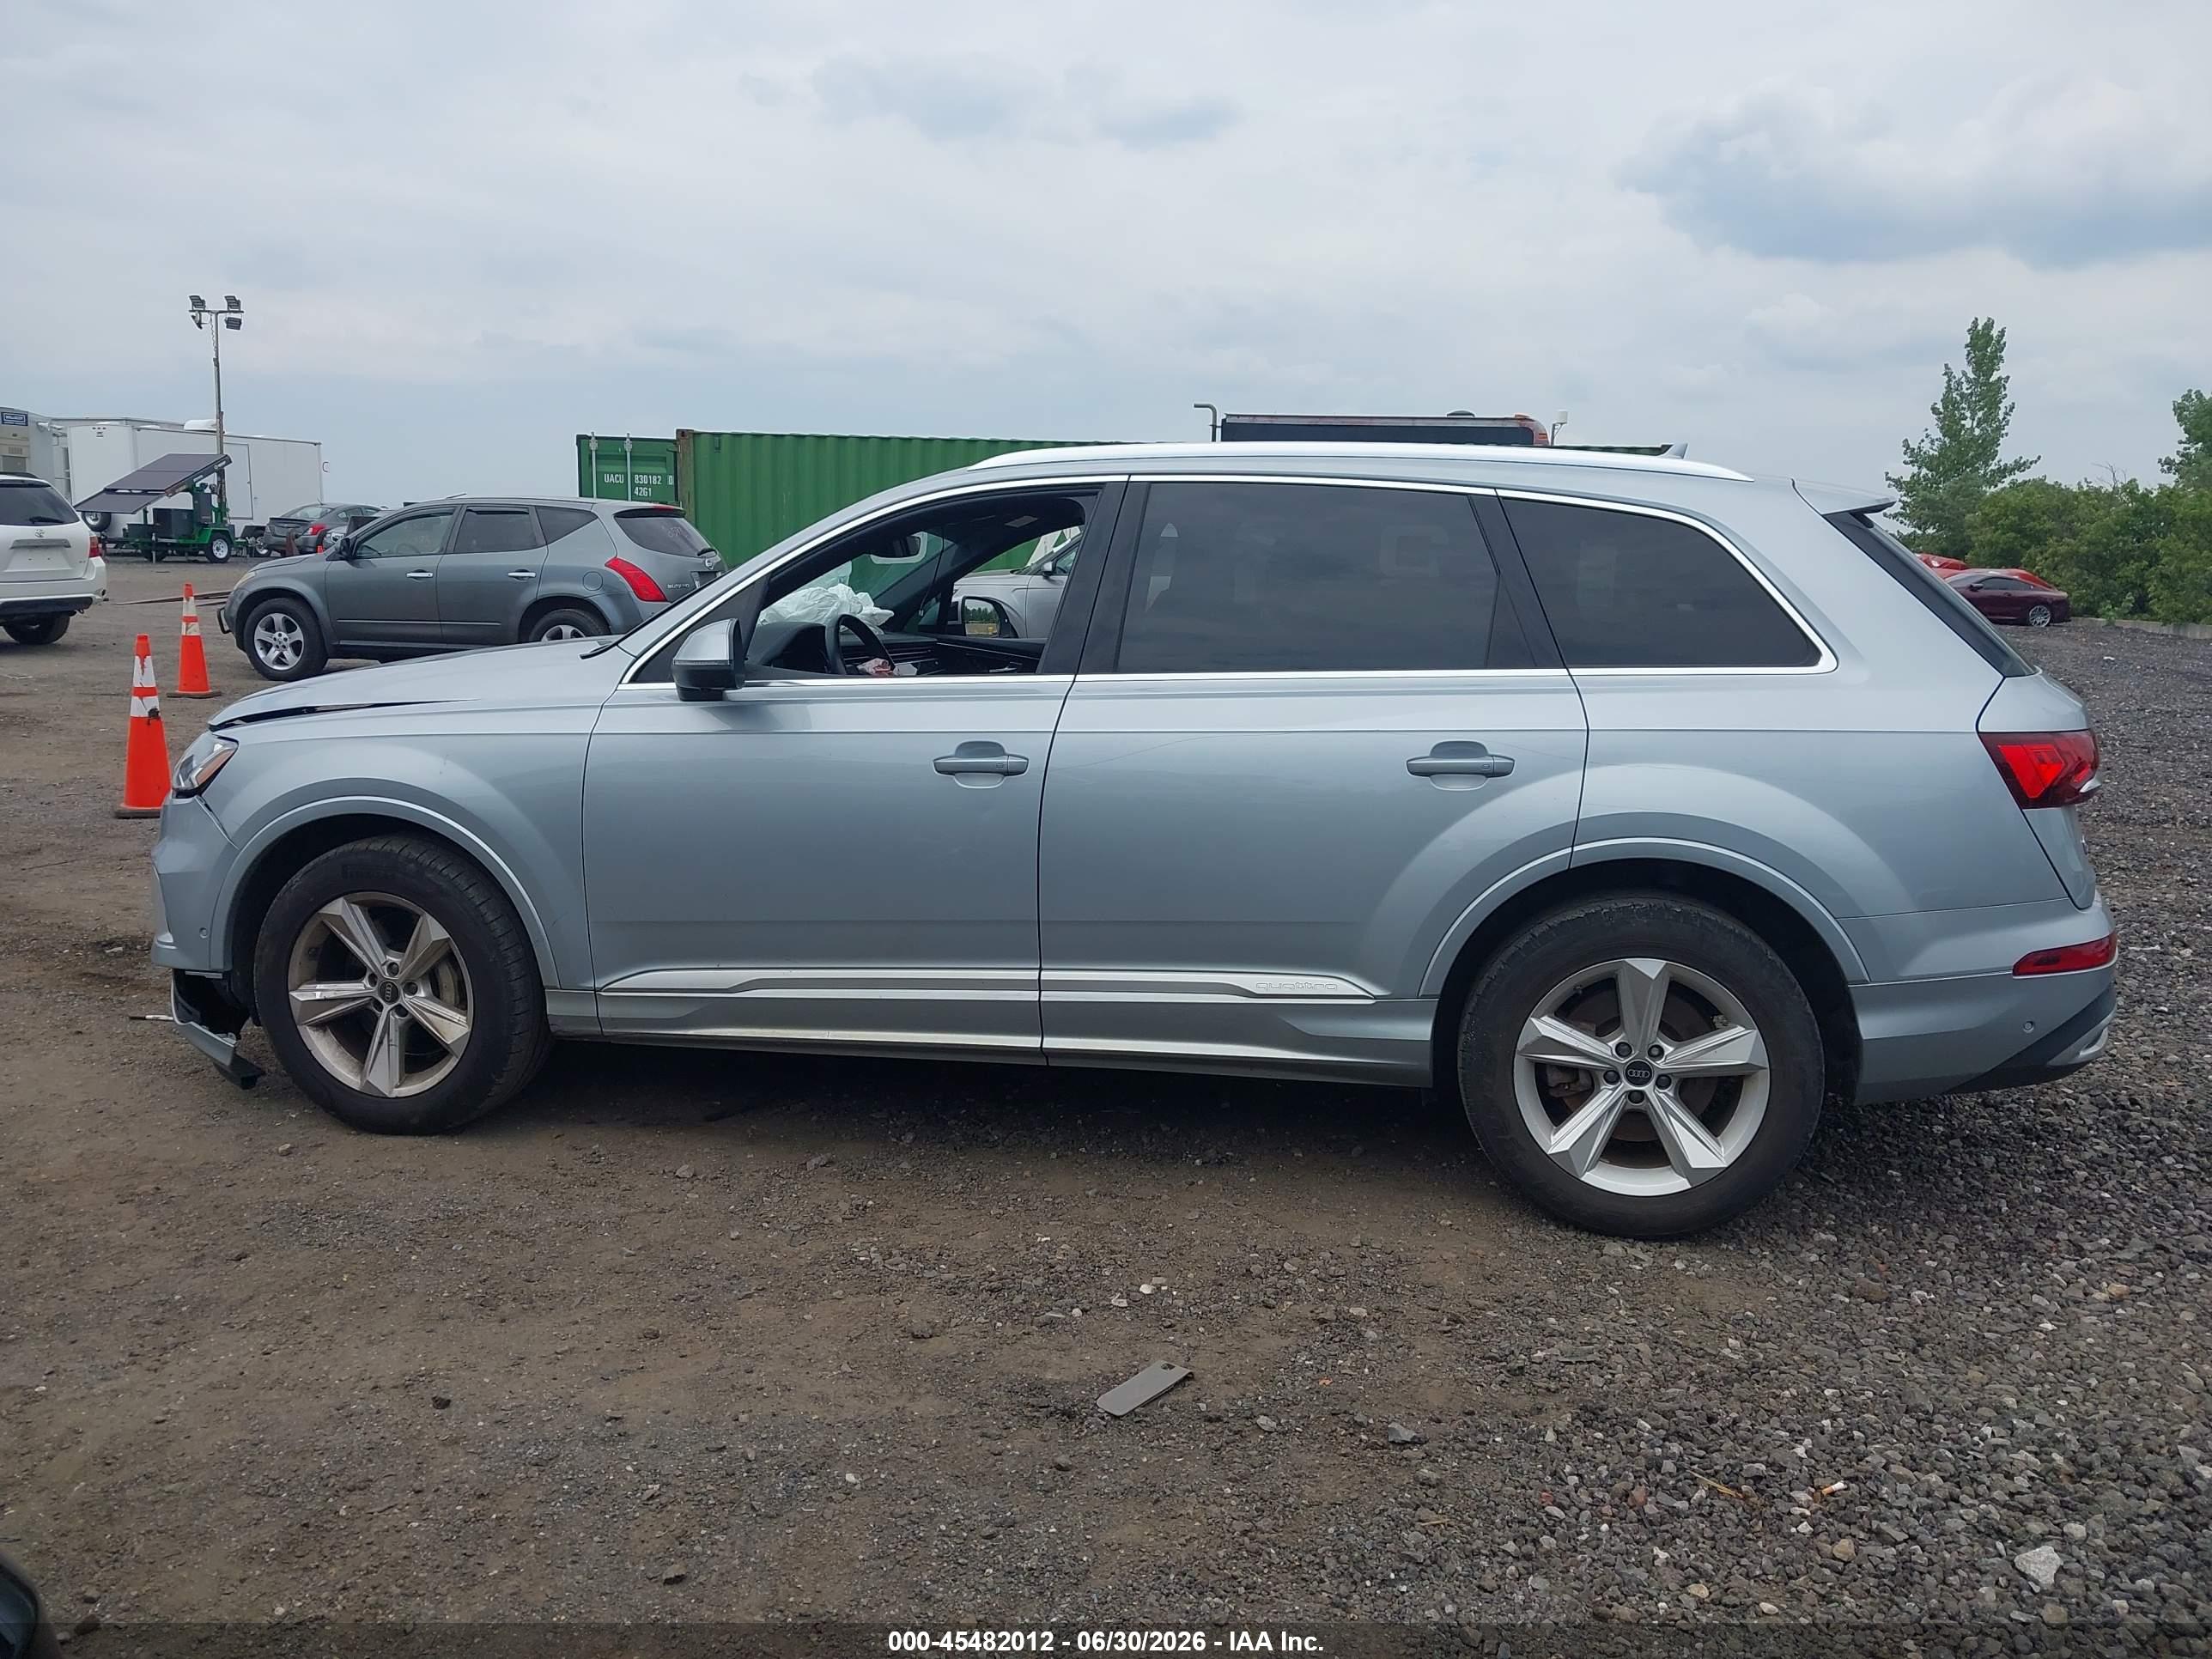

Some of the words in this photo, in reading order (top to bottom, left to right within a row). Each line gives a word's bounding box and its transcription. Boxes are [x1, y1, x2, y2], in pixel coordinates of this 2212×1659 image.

[604, 473, 624, 483] UACU
[634, 474, 662, 485] 830182
[634, 486, 652, 497] 42G1
[1255, 981, 1338, 993] quattro
